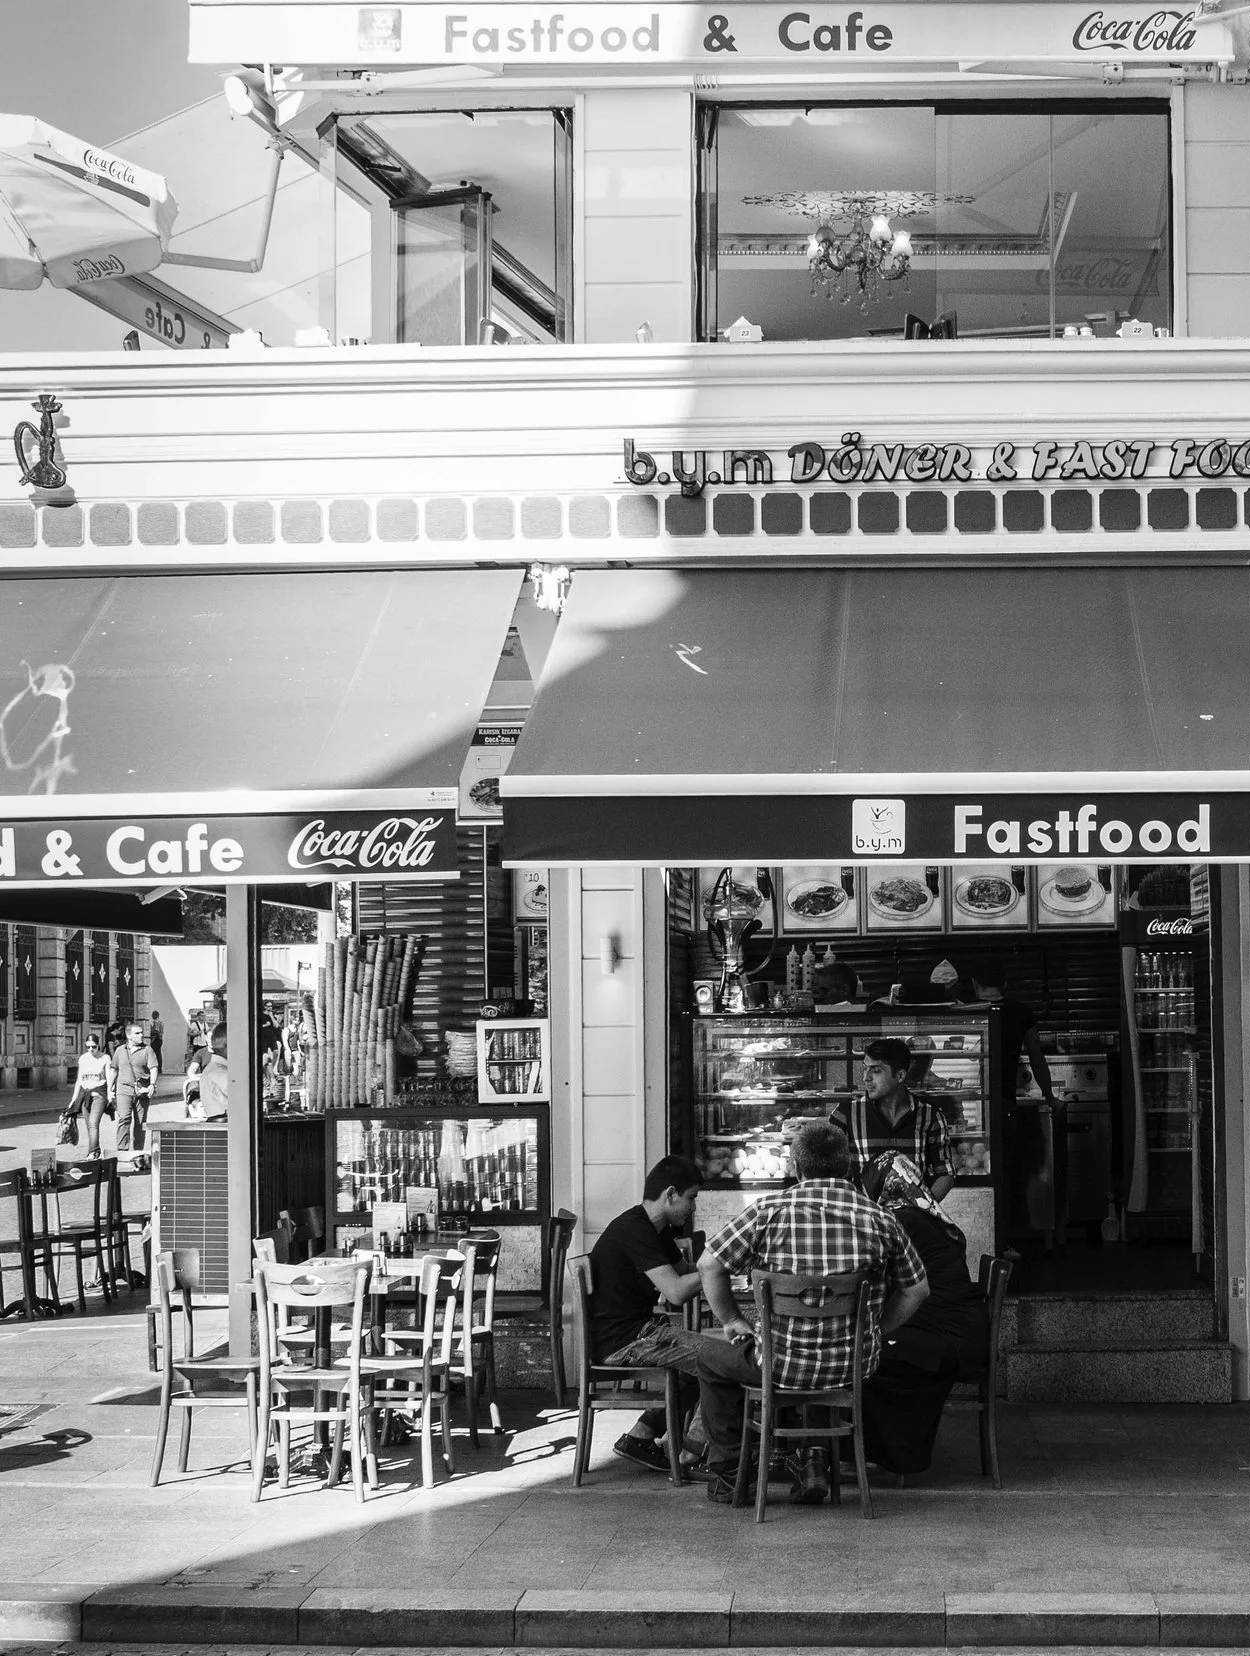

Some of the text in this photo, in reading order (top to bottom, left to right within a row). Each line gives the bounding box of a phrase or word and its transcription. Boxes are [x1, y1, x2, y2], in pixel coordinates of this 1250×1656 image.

[444, 12, 894, 53] Fastfood & Cafe
[1072, 11, 1197, 51] Coca-Cola
[83, 149, 136, 184] Coca-Cola
[623, 438, 773, 498] b.y.m
[788, 431, 973, 483] DÖNER
[986, 441, 1017, 481] &
[1032, 440, 1155, 481] FAST
[41, 829, 84, 876] &
[107, 823, 244, 874] Cafe
[287, 816, 444, 868] Coca-Cola
[855, 833, 903, 853] b.y.m
[954, 804, 1211, 853] Fastfood
[1146, 917, 1193, 936] Coca-Cola
